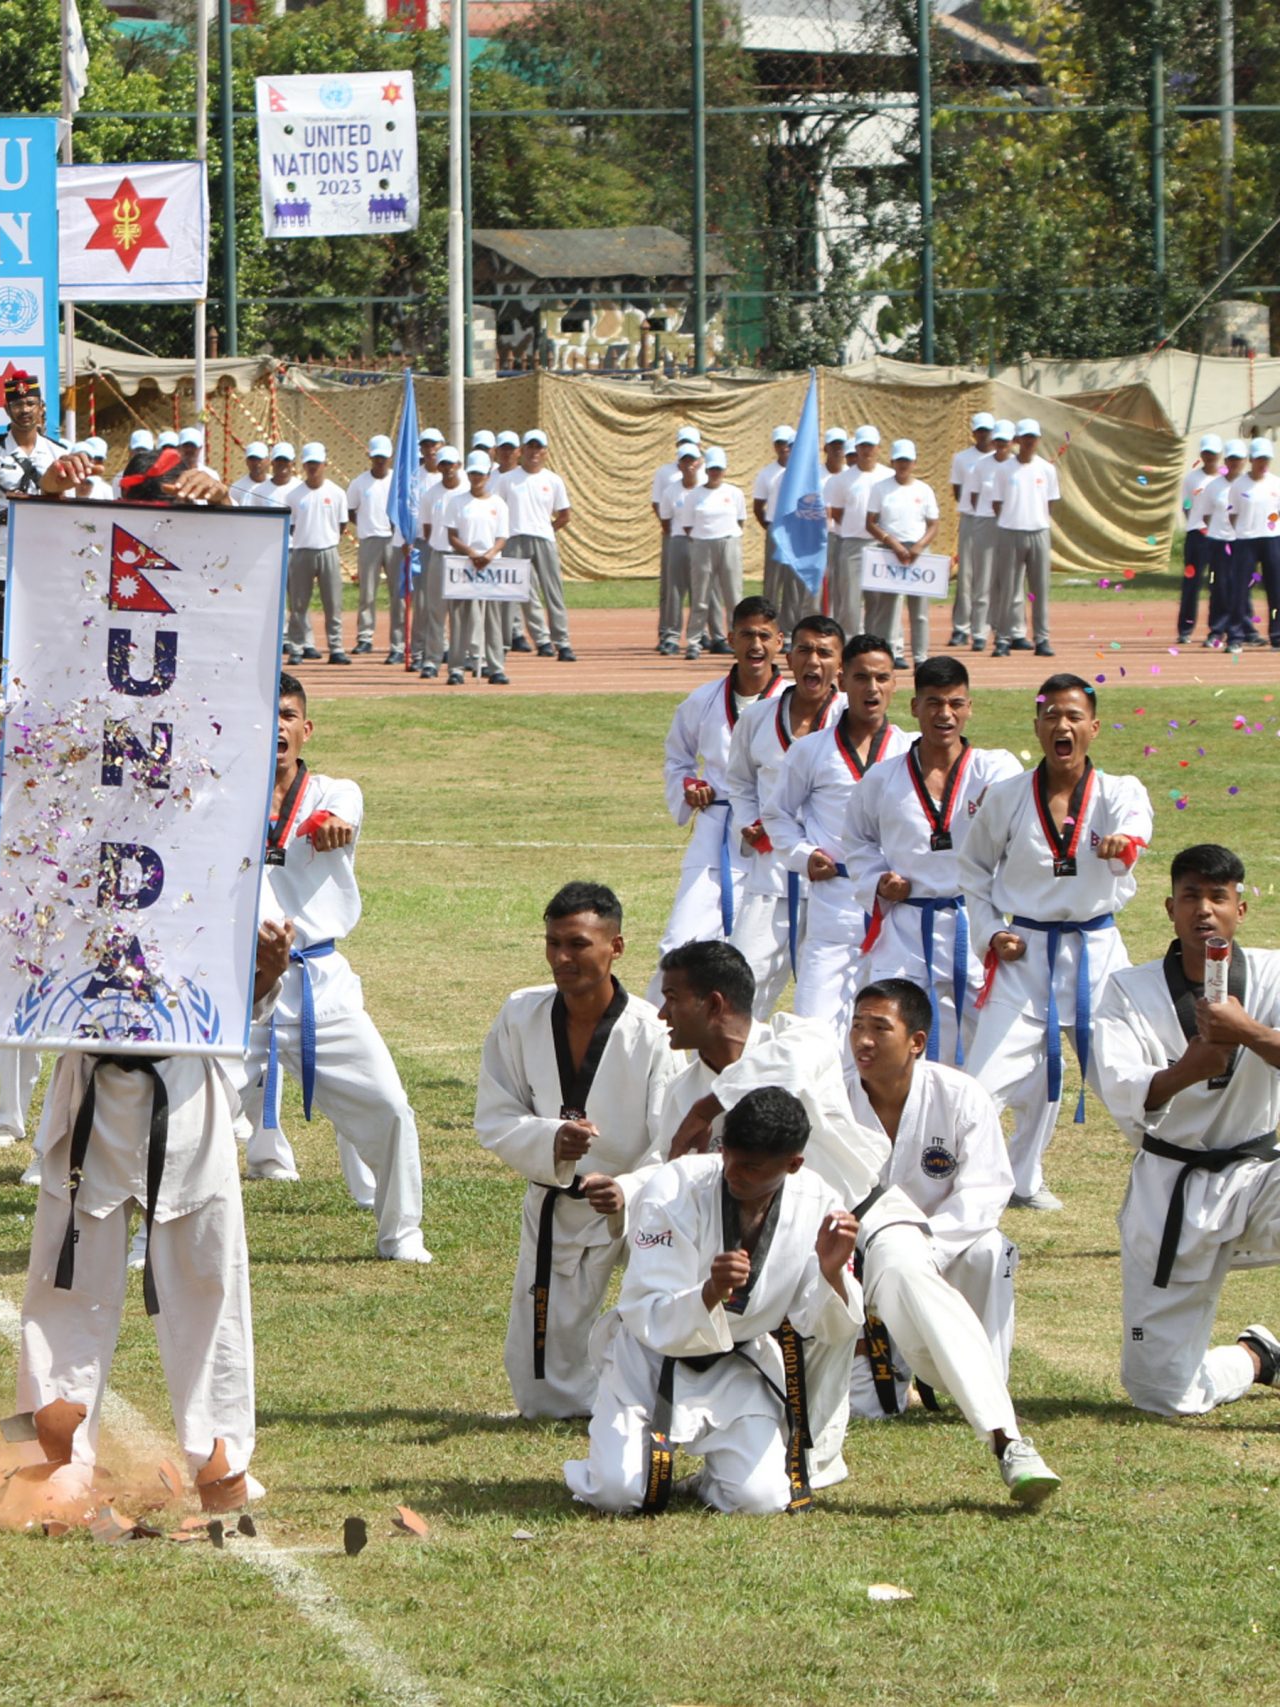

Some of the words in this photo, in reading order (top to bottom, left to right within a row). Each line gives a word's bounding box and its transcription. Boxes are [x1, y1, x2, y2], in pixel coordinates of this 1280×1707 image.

[304, 124, 371, 148] UNITED
[272, 151, 359, 176] NATIONS
[367, 149, 404, 173] DAY
[317, 179, 362, 196] 2023
[450, 568, 522, 584] UNSMIL
[872, 563, 936, 584] UNTSO
